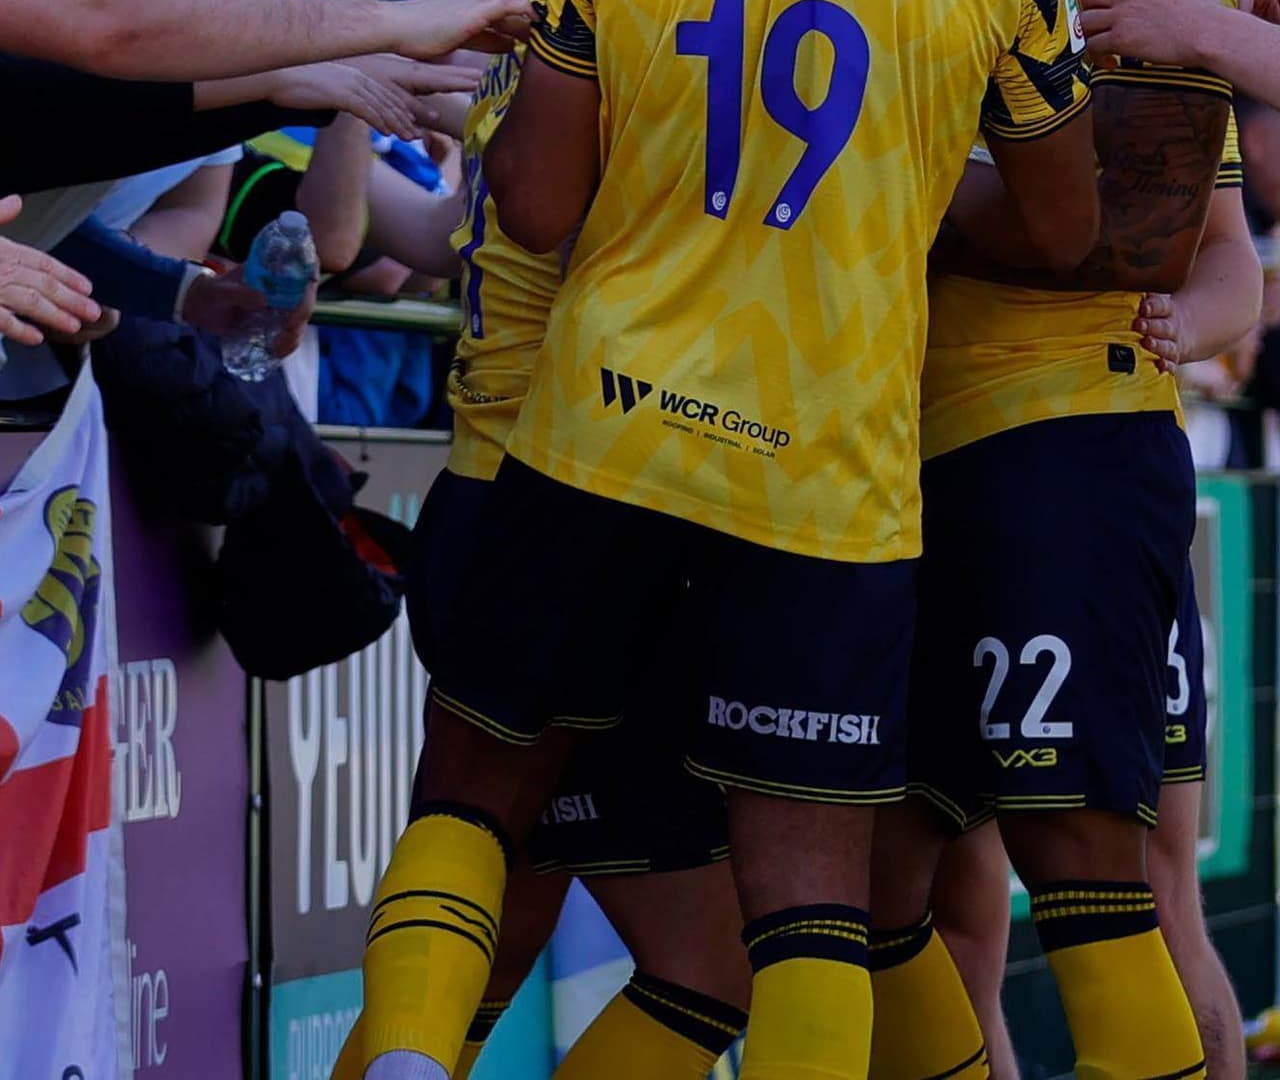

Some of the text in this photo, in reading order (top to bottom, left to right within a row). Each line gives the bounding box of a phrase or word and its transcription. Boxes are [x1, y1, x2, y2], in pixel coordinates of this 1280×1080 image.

[659, 390, 790, 450] WCR Group
[973, 633, 1074, 740] 22
[708, 695, 881, 745] ROCKFISH
[991, 747, 1058, 769] VX3
